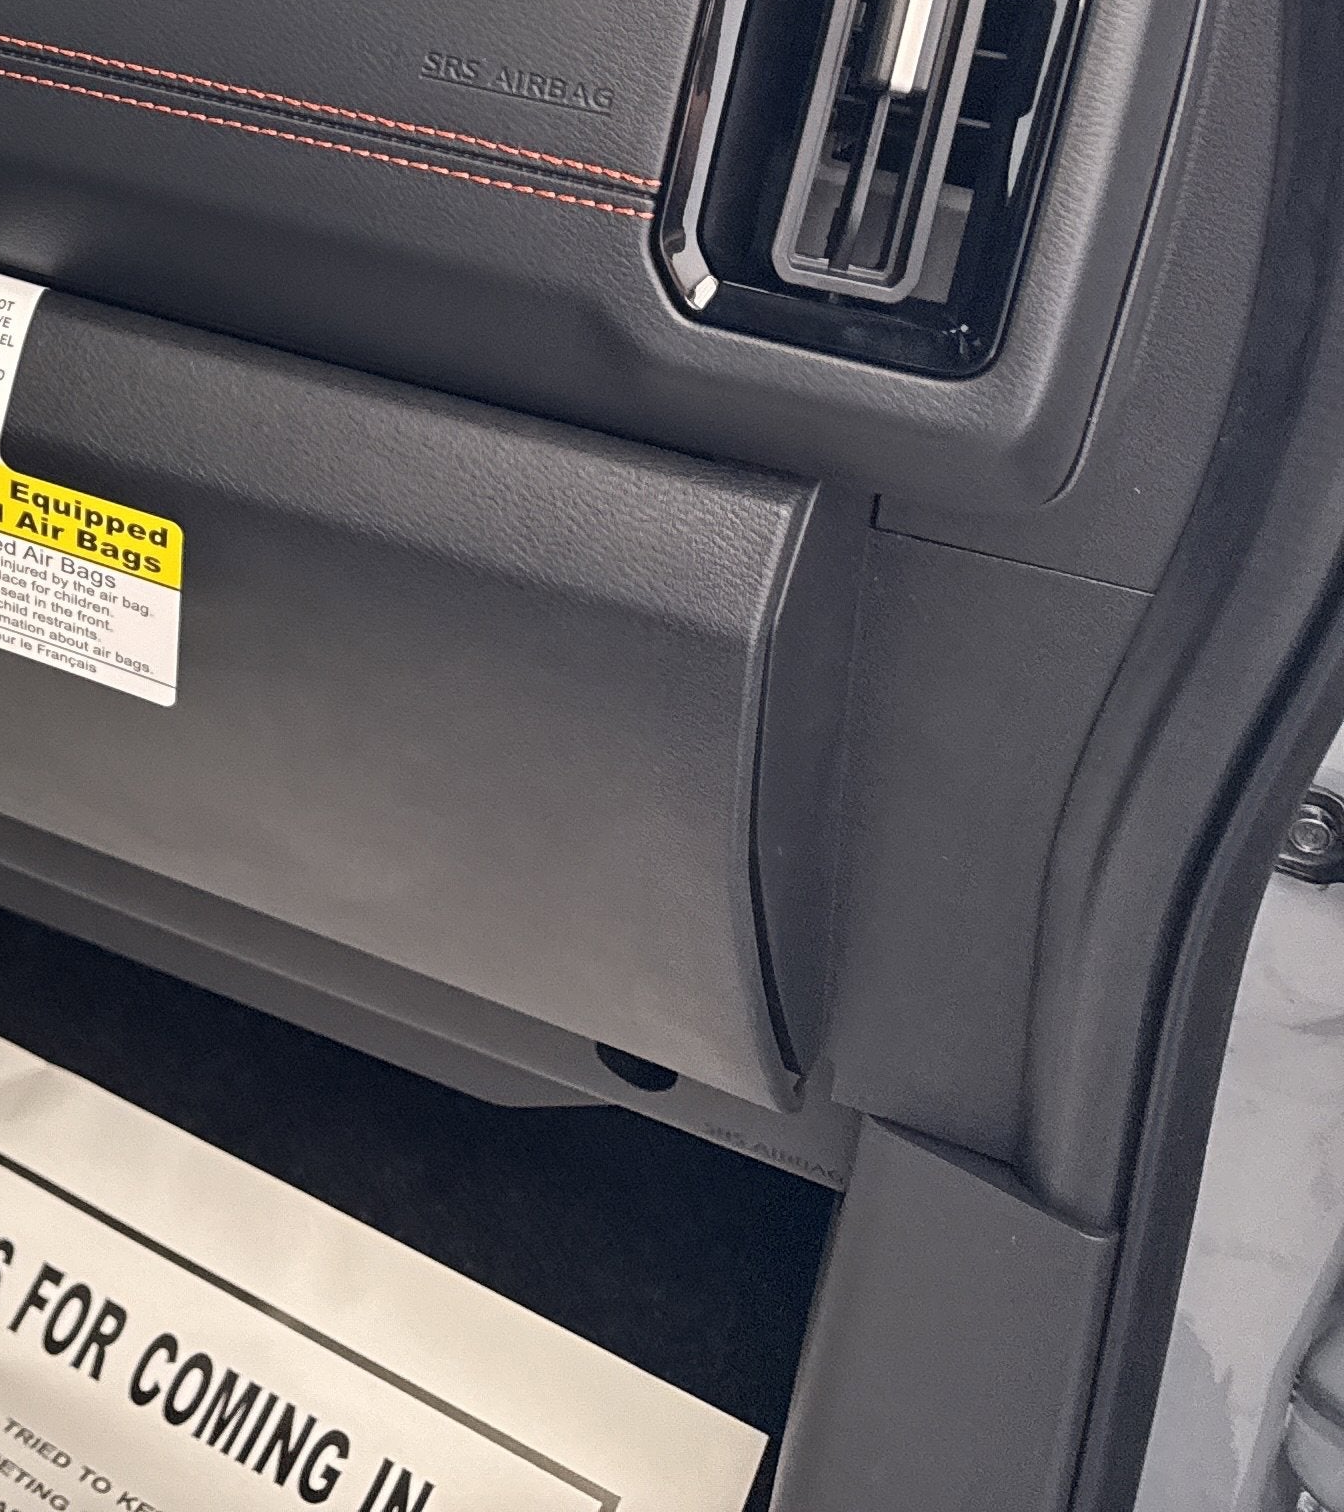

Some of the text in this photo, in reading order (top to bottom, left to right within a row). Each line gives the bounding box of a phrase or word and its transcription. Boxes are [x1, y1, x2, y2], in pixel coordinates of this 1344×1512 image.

[421, 51, 613, 110] SRS AIRBAG
[10, 479, 168, 548] Equipped
[15, 511, 65, 541] Air
[76, 528, 161, 573] Bags
[23, 546, 53, 567] Air
[61, 557, 116, 588] Bags
[0, 556, 47, 581] injured
[52, 572, 69, 589] by
[73, 581, 95, 597] the
[100, 591, 118, 604] air
[123, 596, 154, 618] bag.
[0, 586, 30, 604] seat
[35, 595, 47, 609] in
[51, 601, 73, 618] the
[77, 610, 114, 632] front.
[31, 580, 51, 595] for
[54, 590, 115, 618] children.
[32, 610, 102, 642] restraints.
[20, 638, 32, 650] le
[37, 644, 97, 673] Français
[49, 631, 89, 652] about
[93, 645, 112, 659] air
[115, 651, 154, 675] bags.
[7, 1261, 128, 1381] FOR
[128, 1332, 351, 1505] COMING
[3, 1417, 72, 1470] TRIED
[78, 1464, 113, 1495] TO
